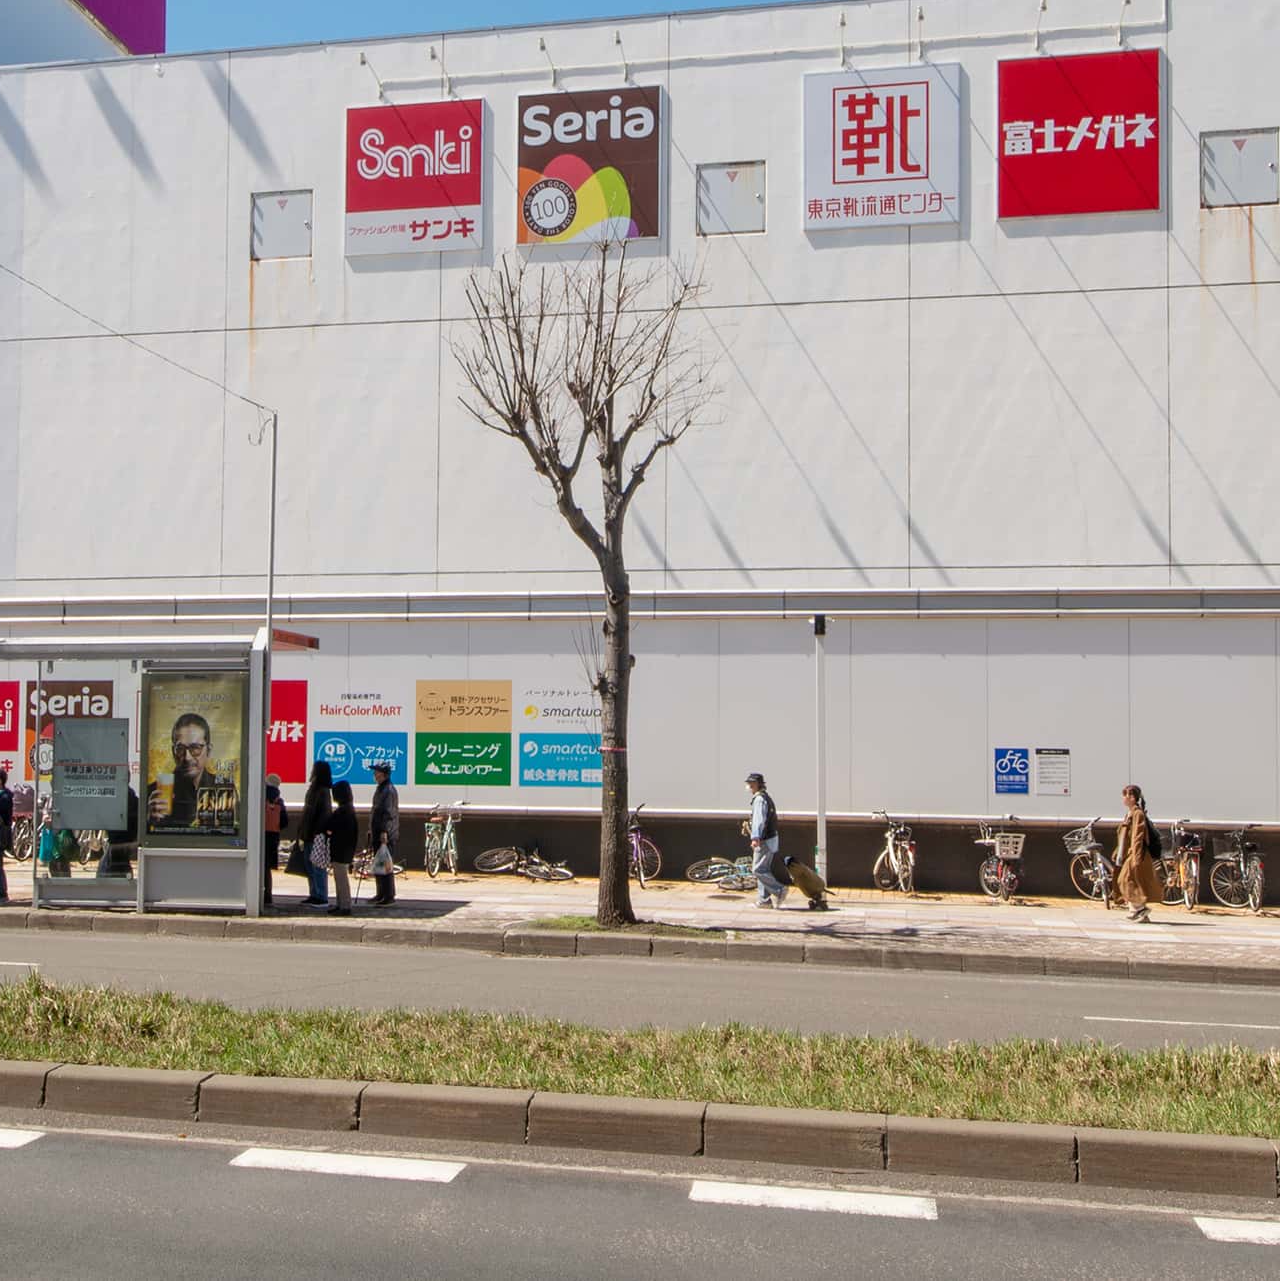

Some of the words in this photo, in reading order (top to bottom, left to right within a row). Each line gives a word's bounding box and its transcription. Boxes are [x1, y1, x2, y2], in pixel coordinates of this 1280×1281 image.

[523, 95, 655, 146] Seria
[841, 93, 921, 176] 靴
[1002, 113, 1157, 156] 富士メガネ
[357, 125, 473, 180] Sanki
[533, 195, 567, 222] 100
[808, 192, 956, 220] 東京靴流通センター
[349, 224, 406, 237] ファッション市場
[409, 217, 475, 241] サンキ
[30, 686, 110, 716] Seria
[343, 705, 371, 716] Color
[449, 706, 509, 716] トランスファー
[542, 706, 602, 717] smartwa
[324, 743, 346, 756] QB
[354, 745, 404, 758] ヘアカット
[425, 743, 502, 758] クリーニング
[542, 743, 600, 755] smartcu
